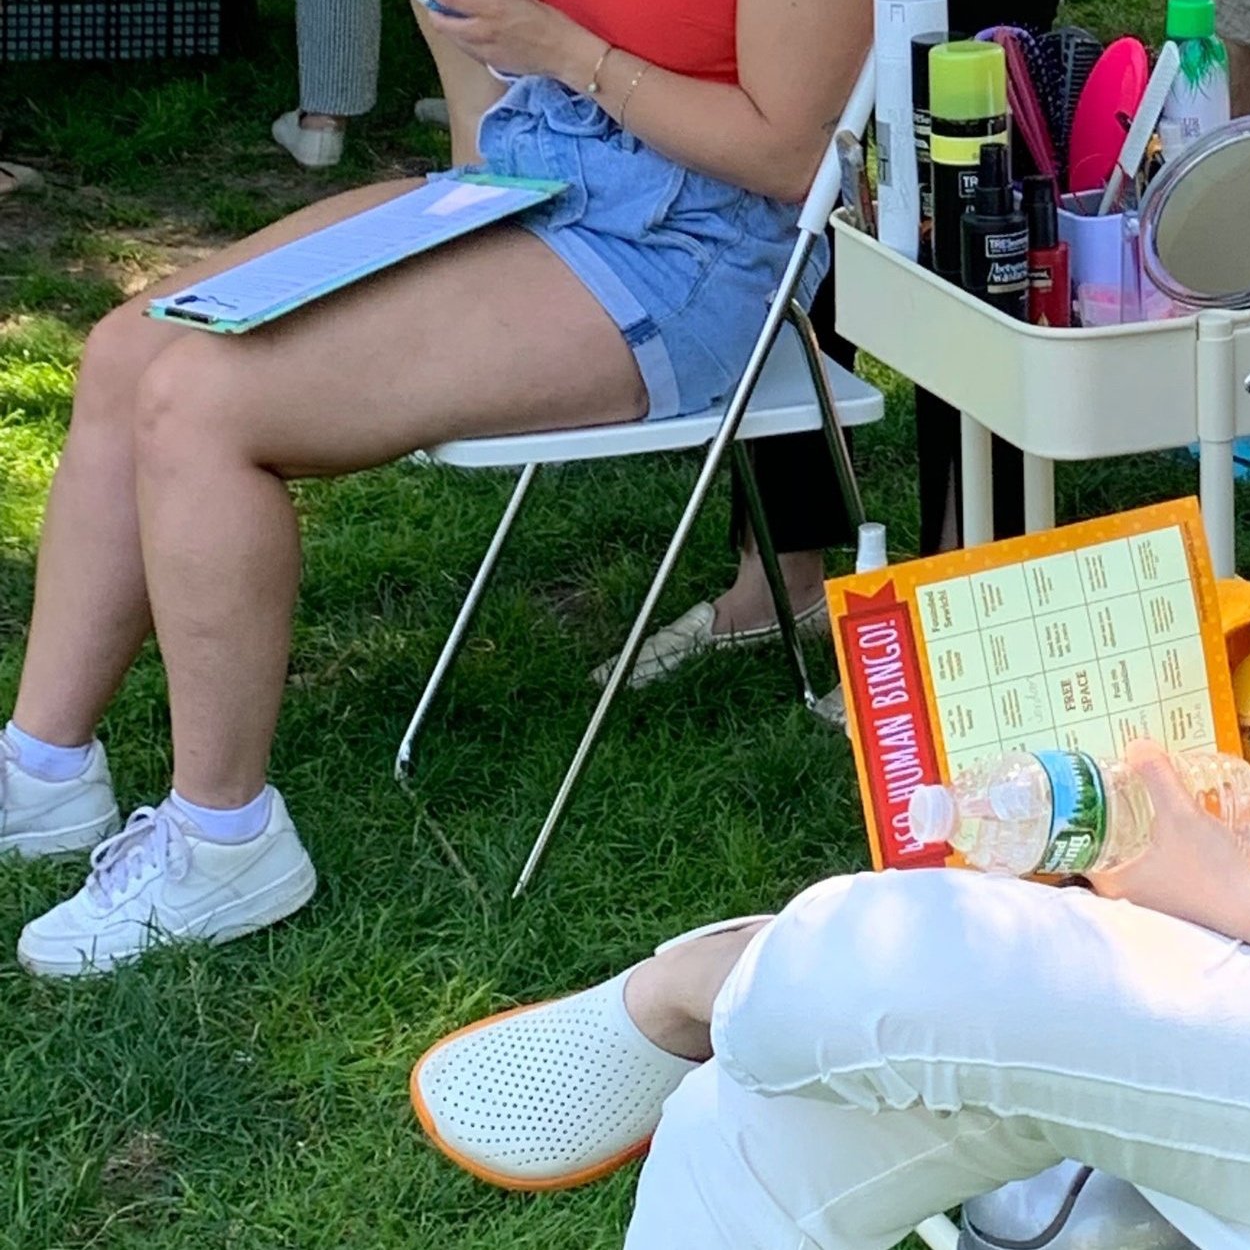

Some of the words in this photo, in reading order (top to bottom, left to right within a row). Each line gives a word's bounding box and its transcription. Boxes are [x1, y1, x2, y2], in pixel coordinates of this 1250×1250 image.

[856, 618, 909, 710] BINGO!
[1060, 679, 1076, 711] FREE
[1075, 669, 1093, 713] SPACE
[872, 712, 924, 804] HUMAN
